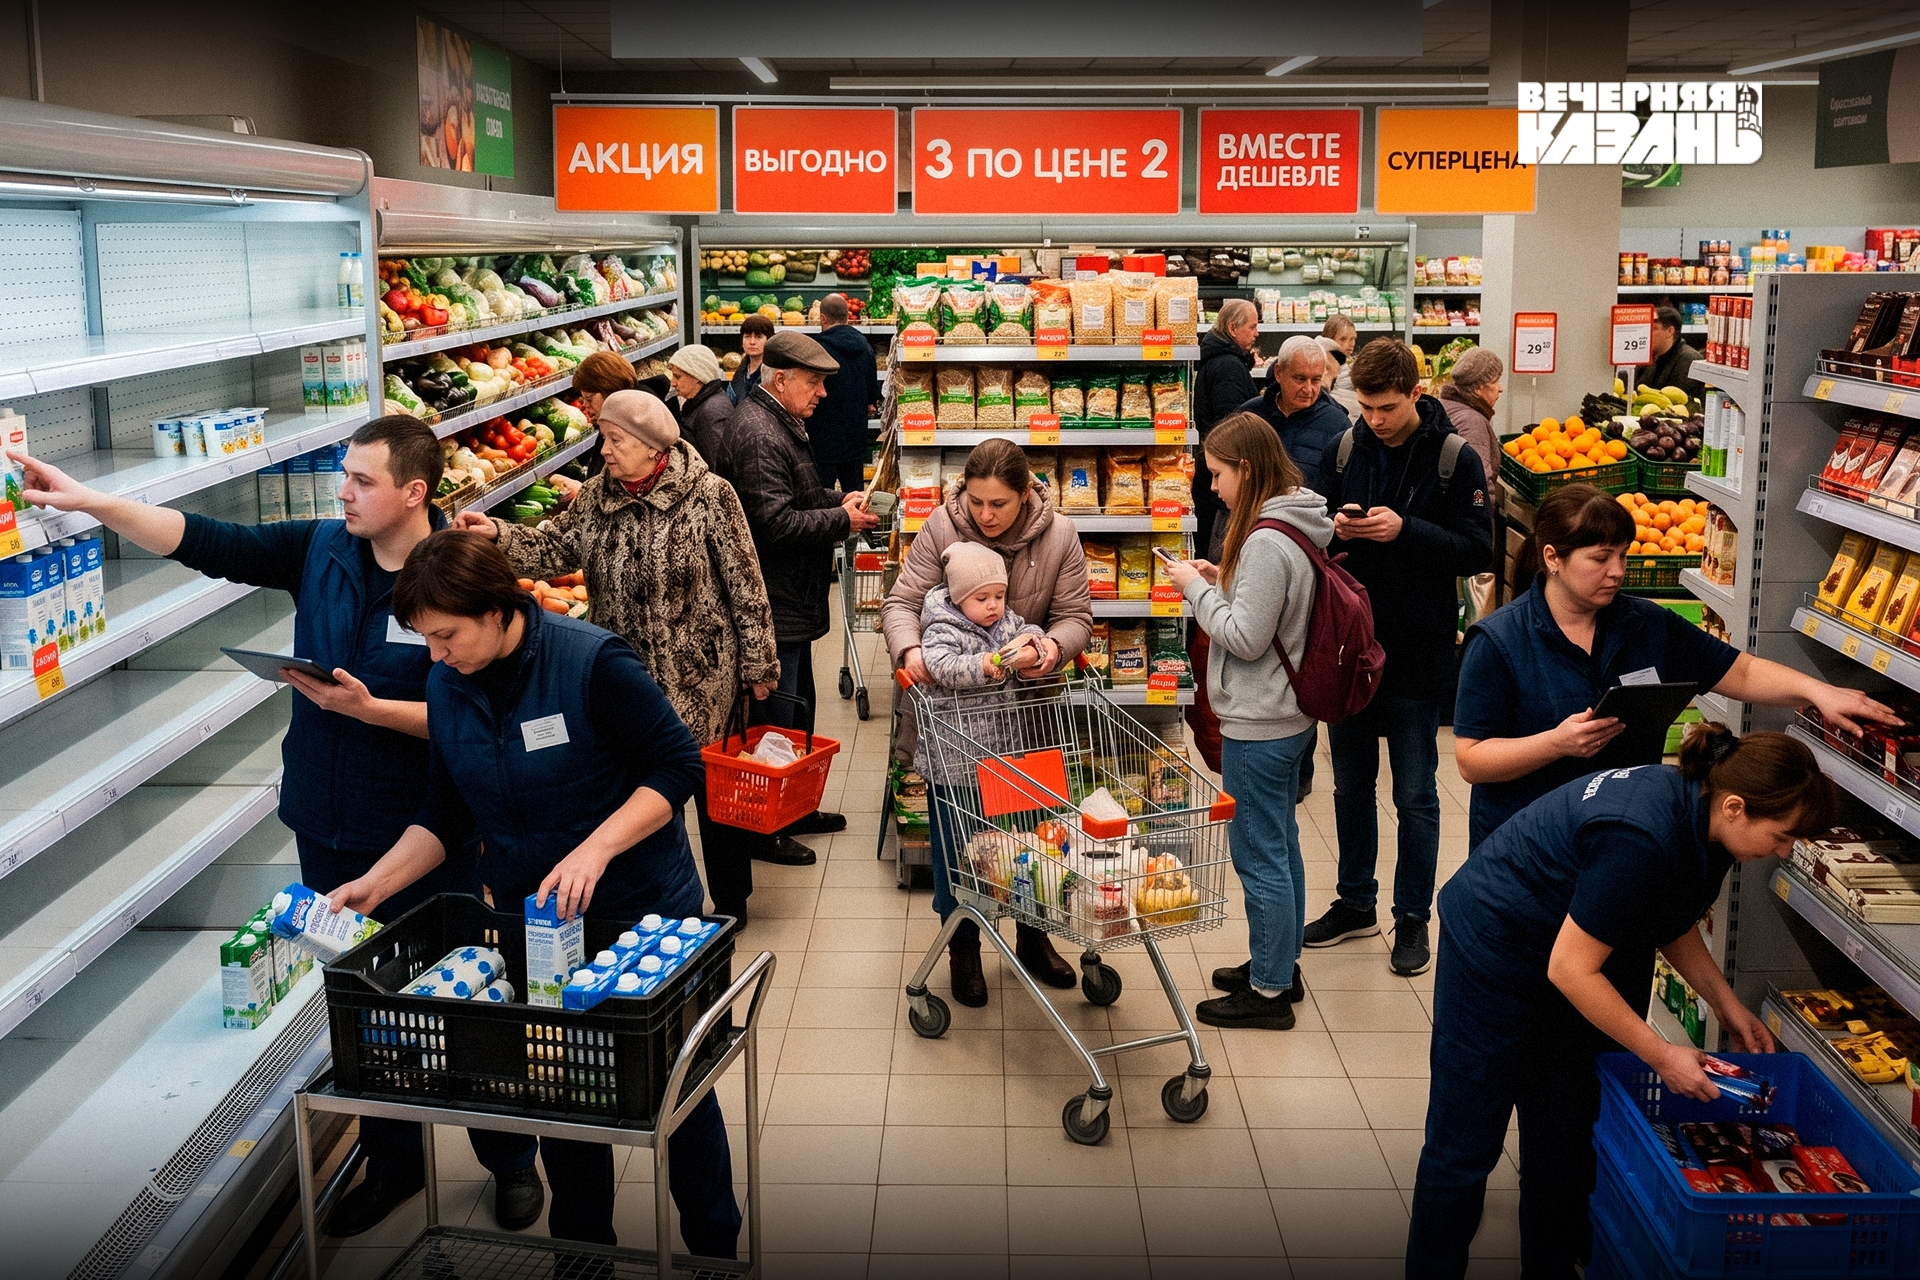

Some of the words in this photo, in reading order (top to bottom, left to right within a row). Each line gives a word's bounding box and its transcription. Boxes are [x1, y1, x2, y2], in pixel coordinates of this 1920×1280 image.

[1218, 133, 1341, 160] ВМЕСТЕ
[569, 142, 703, 180] АКЦИЯ
[745, 149, 887, 177] ВЫГОДНО
[926, 138, 953, 179] 3
[967, 147, 1023, 178] ПО
[1034, 147, 1127, 183] ЦЕНЕ
[1141, 138, 1168, 178] 2
[1216, 165, 1340, 191] ДЕШЕВЛЕ
[1527, 344, 1542, 354] 29
[1624, 340, 1639, 350] 29
